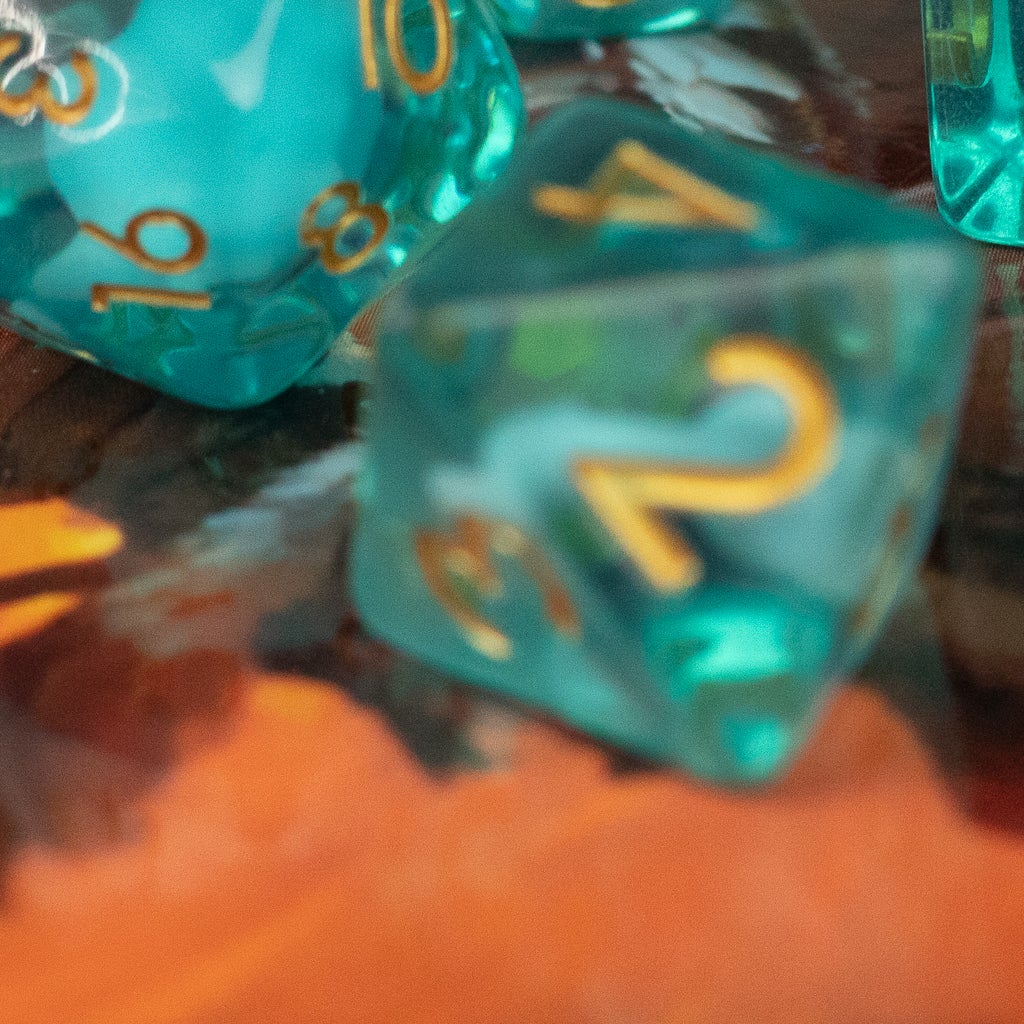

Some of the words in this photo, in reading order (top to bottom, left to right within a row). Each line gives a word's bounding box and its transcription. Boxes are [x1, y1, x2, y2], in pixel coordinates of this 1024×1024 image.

[300, 179, 391, 275] 8
[530, 138, 763, 233] 4
[568, 331, 842, 593] 2
